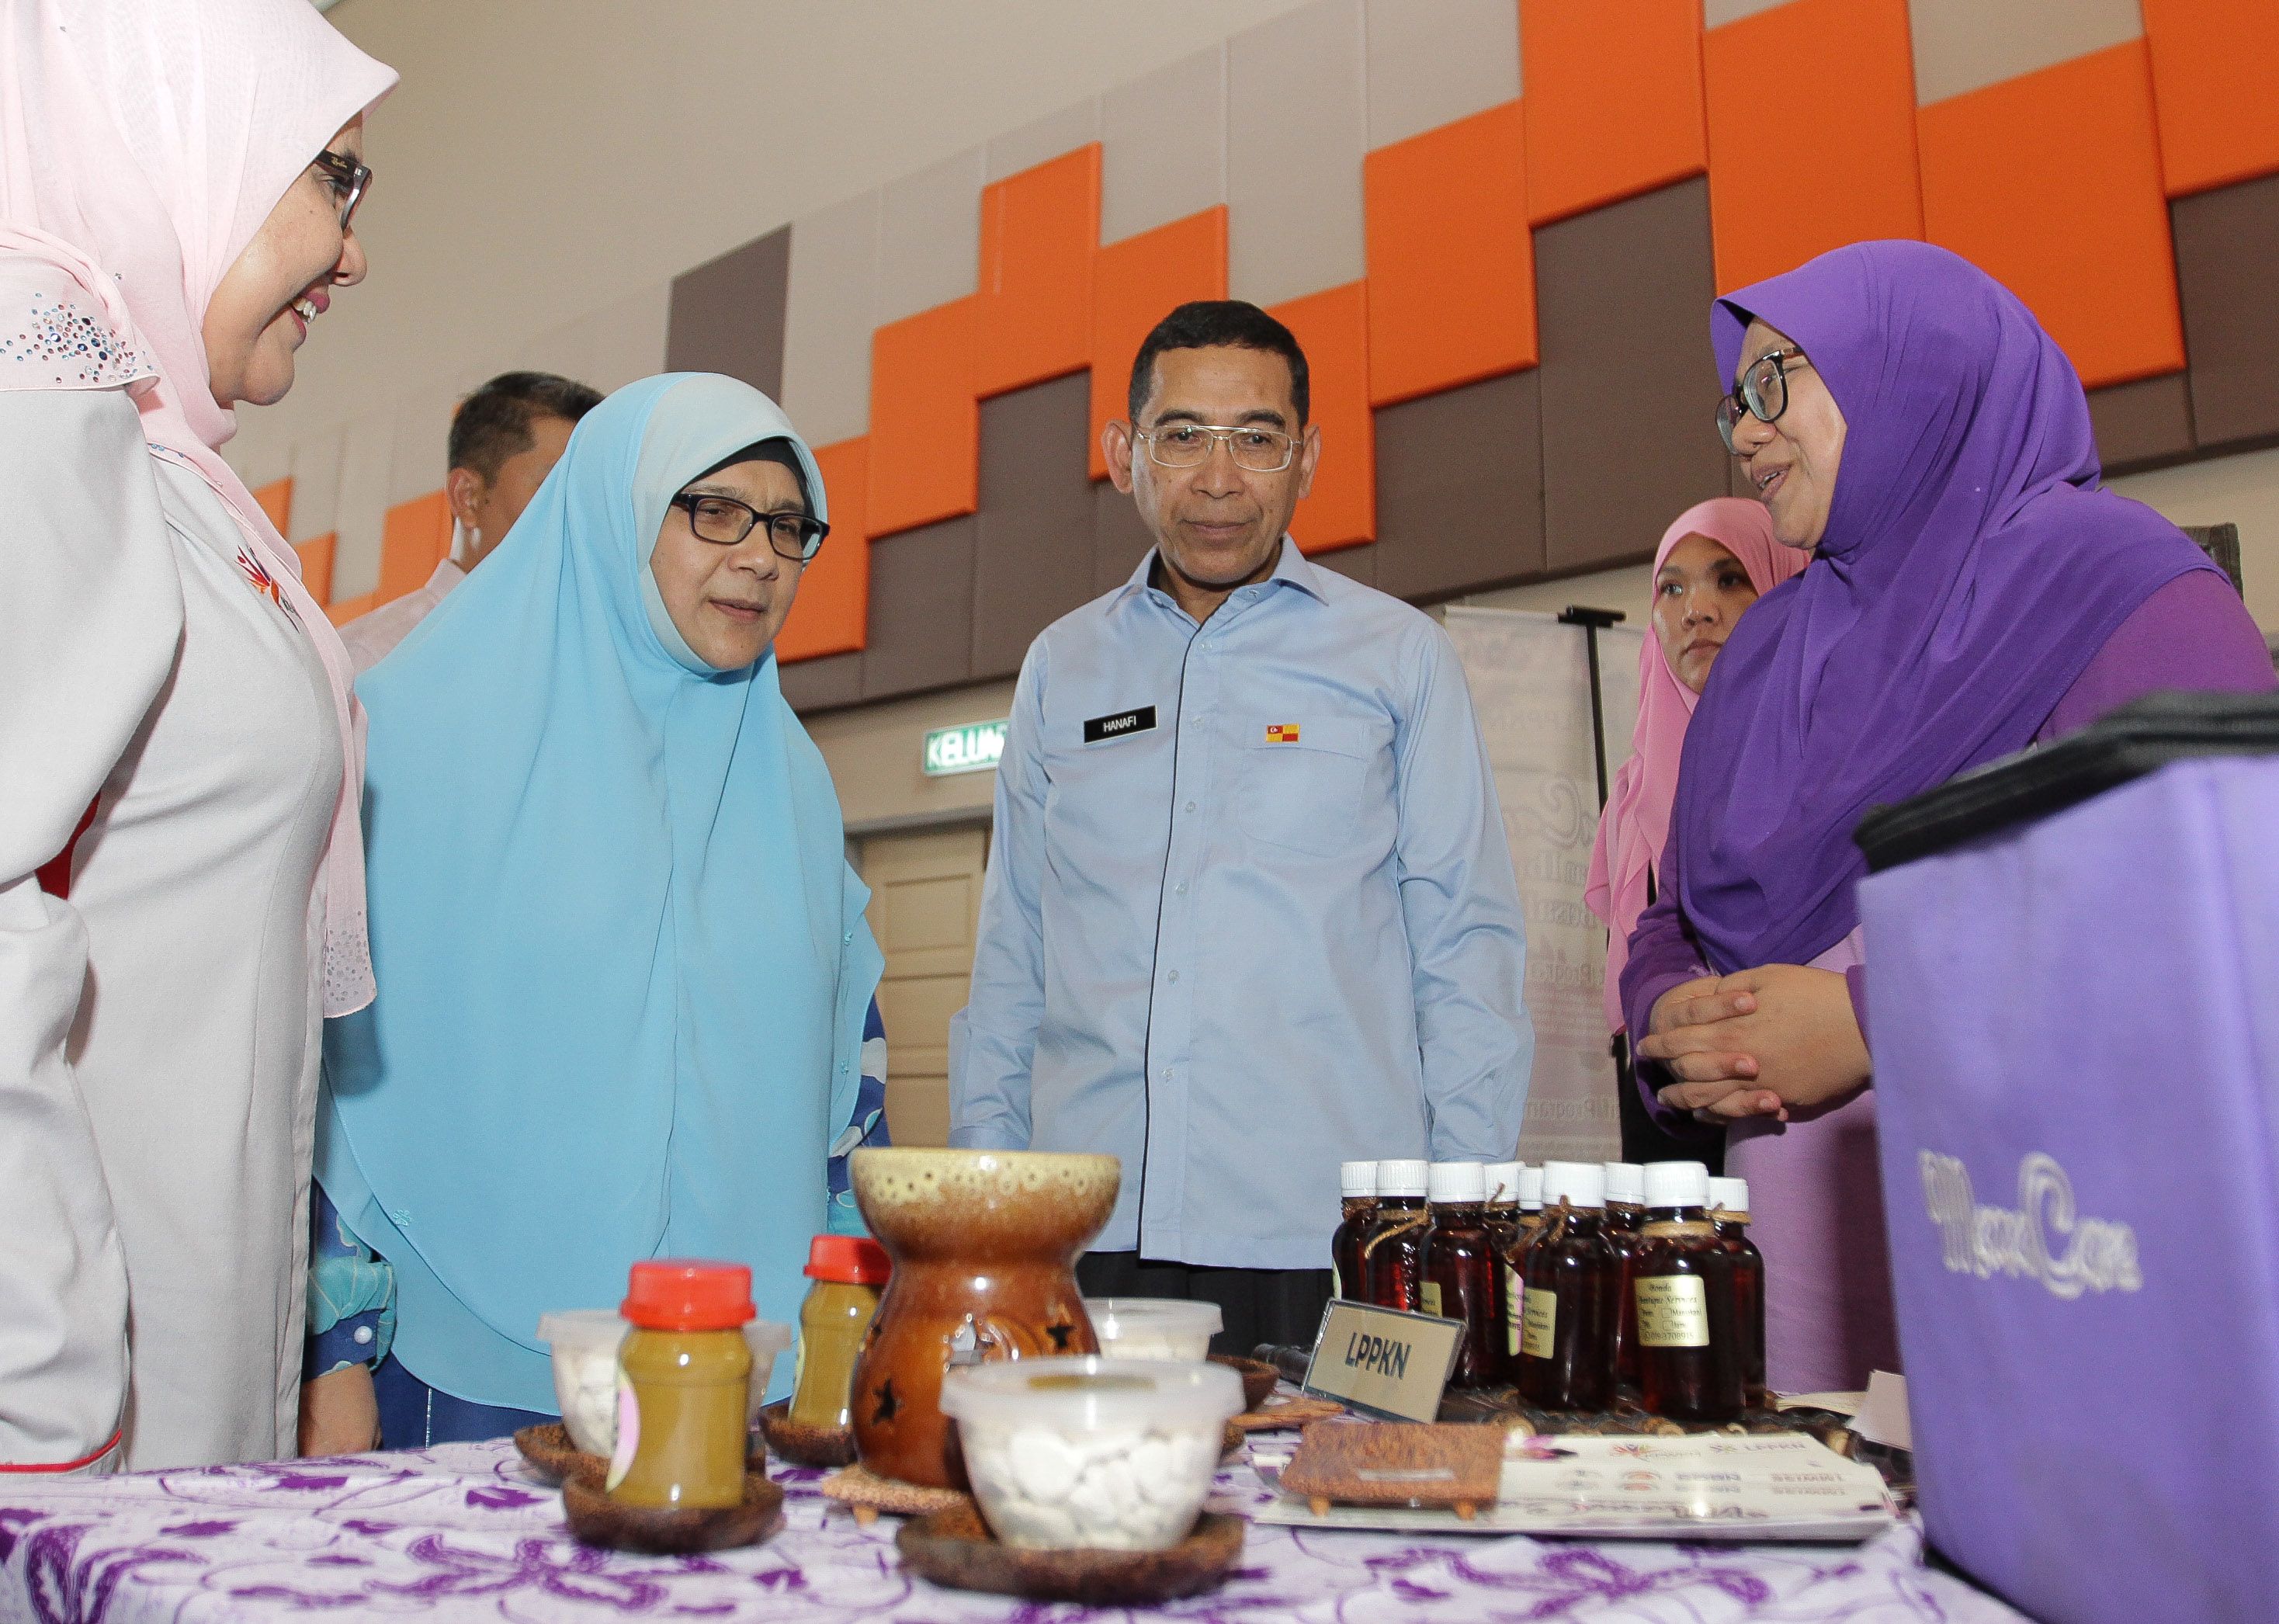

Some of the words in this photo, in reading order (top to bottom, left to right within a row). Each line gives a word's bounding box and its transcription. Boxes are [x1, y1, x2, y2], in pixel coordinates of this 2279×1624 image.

[1103, 715, 1136, 733] HANAFI
[928, 726, 1006, 766] KELUA
[1345, 1332, 1412, 1379] LPPKN
